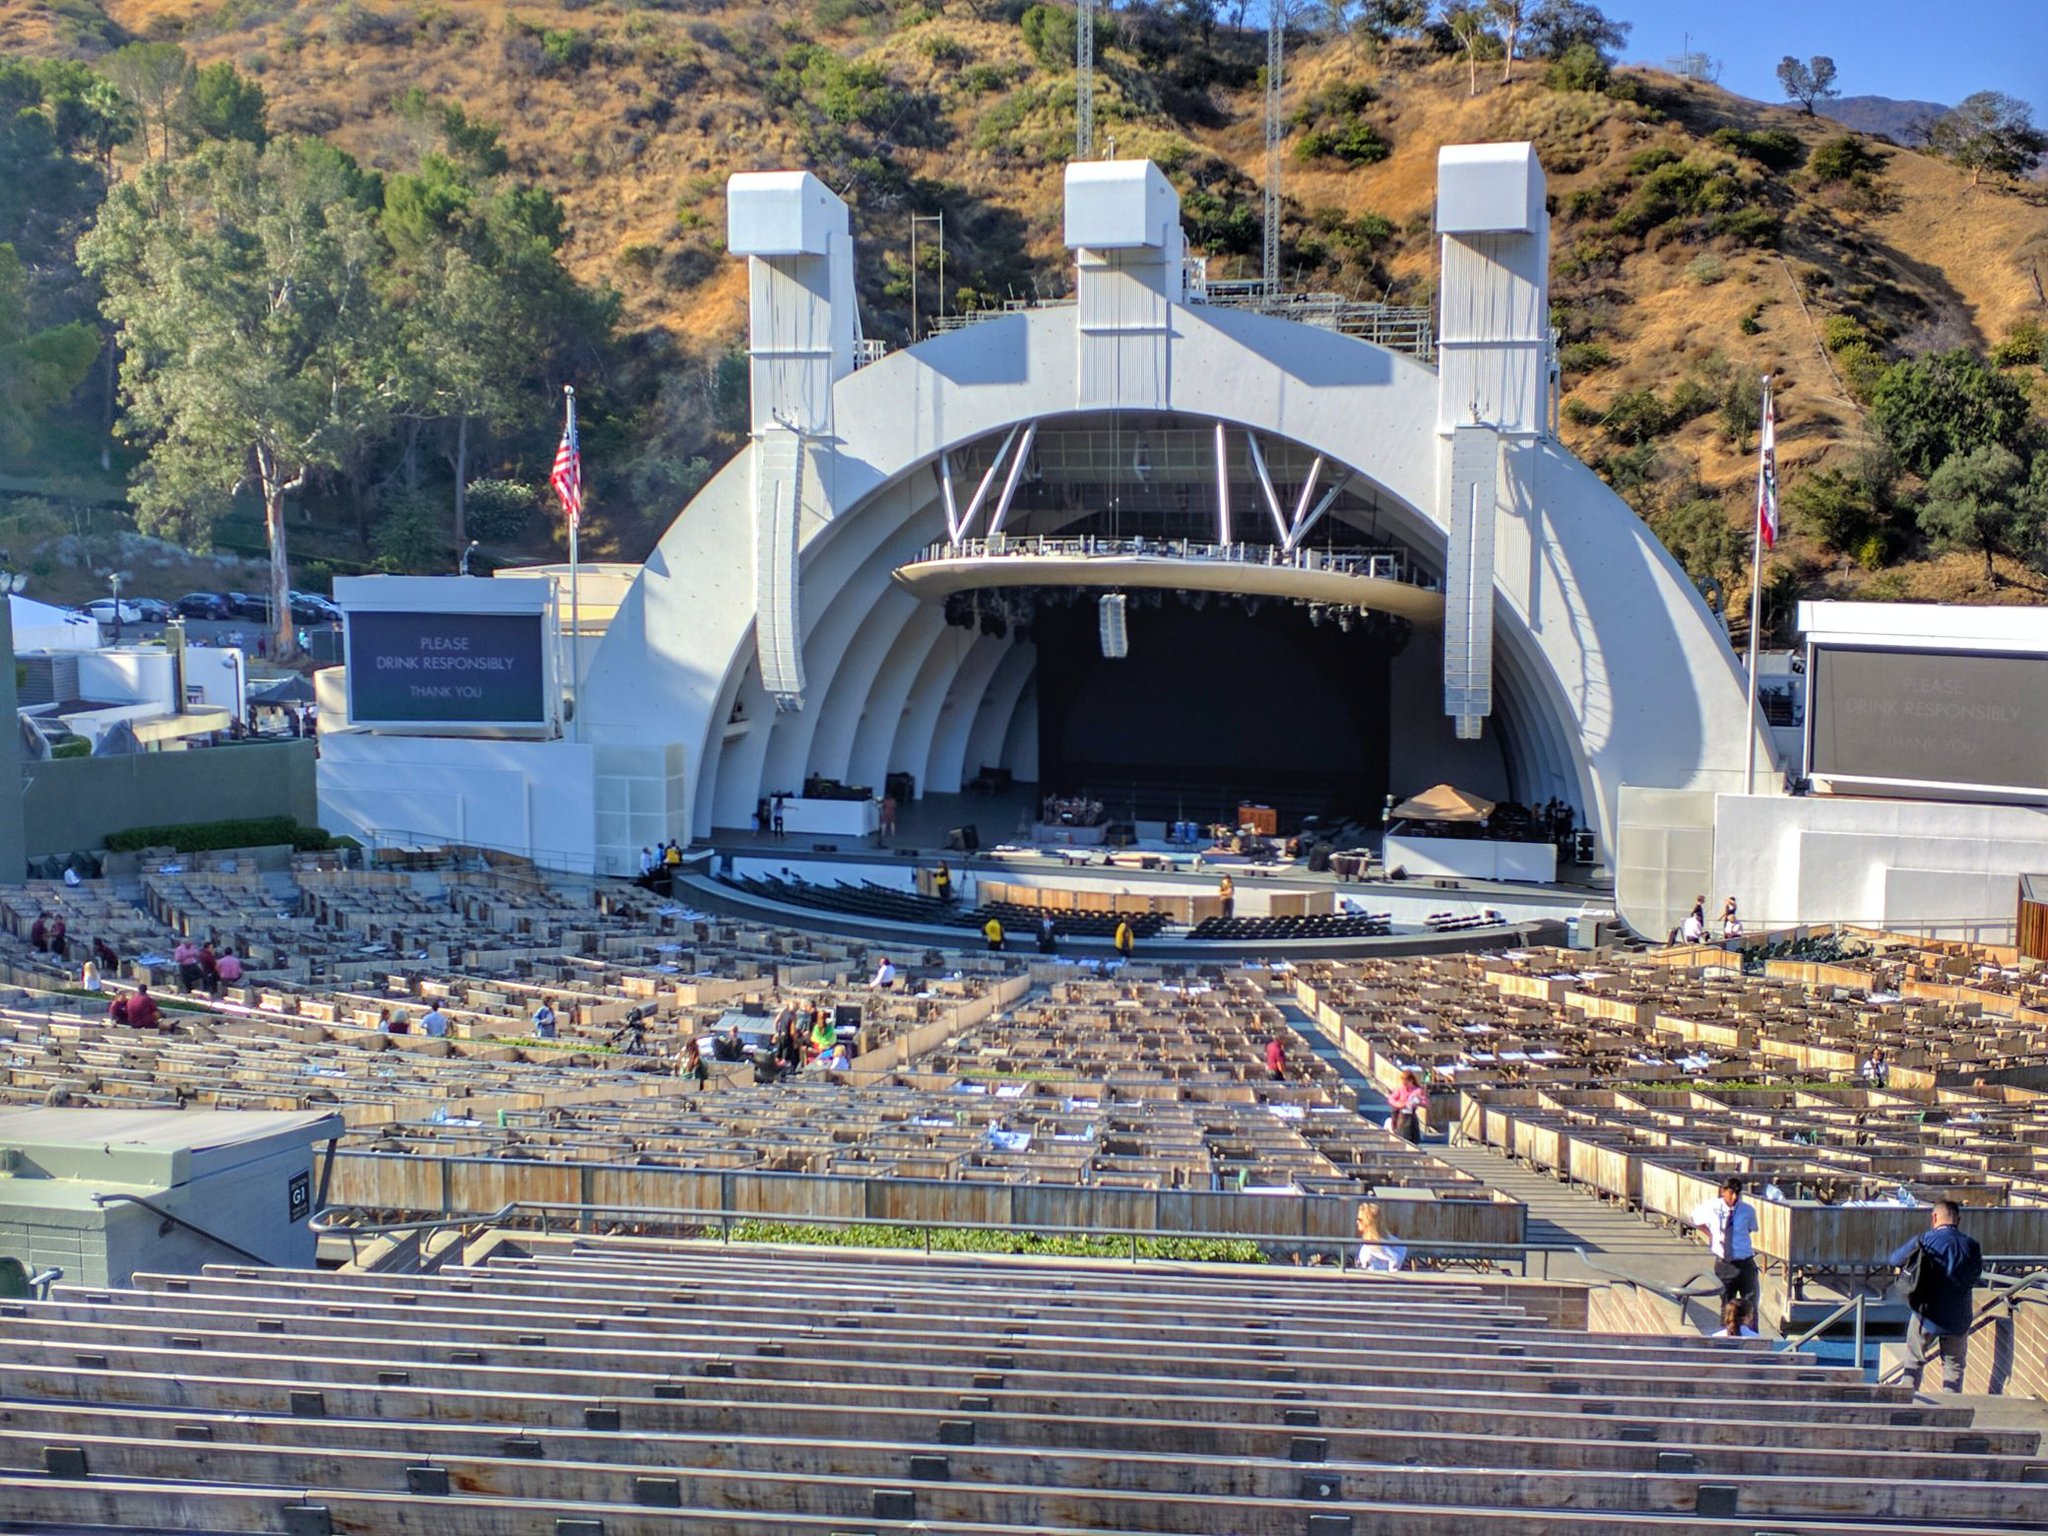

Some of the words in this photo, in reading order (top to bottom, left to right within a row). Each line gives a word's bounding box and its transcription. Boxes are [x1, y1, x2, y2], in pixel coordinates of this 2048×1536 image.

[420, 637, 470, 650] PLEASE
[376, 656, 419, 670] DRINK
[423, 656, 515, 670] RESPONSIBLY
[409, 685, 452, 698] THANK
[455, 685, 483, 698] YOU
[1903, 677, 1964, 695] PLEASE
[1845, 697, 1898, 714] DRINK
[1903, 701, 2021, 721] RESPONSIBLY
[292, 1186, 305, 1205] G1
